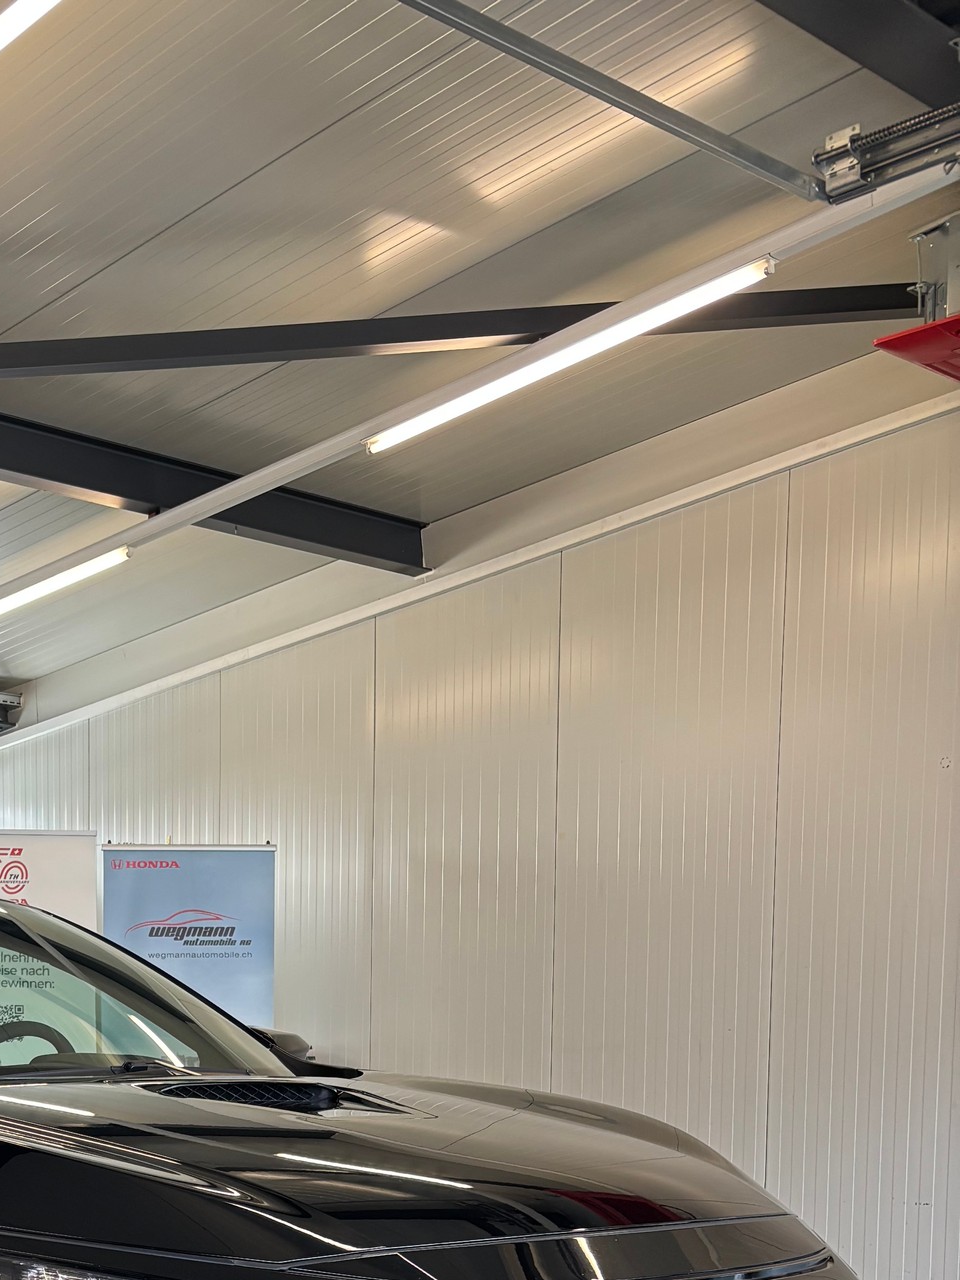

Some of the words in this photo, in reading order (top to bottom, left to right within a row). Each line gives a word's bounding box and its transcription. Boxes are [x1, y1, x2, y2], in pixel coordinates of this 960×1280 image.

[125, 860, 180, 869] HONDA
[148, 926, 236, 941] wegmann
[147, 951, 253, 960] wegmannautomobile.ch
[20, 965, 50, 976] nach
